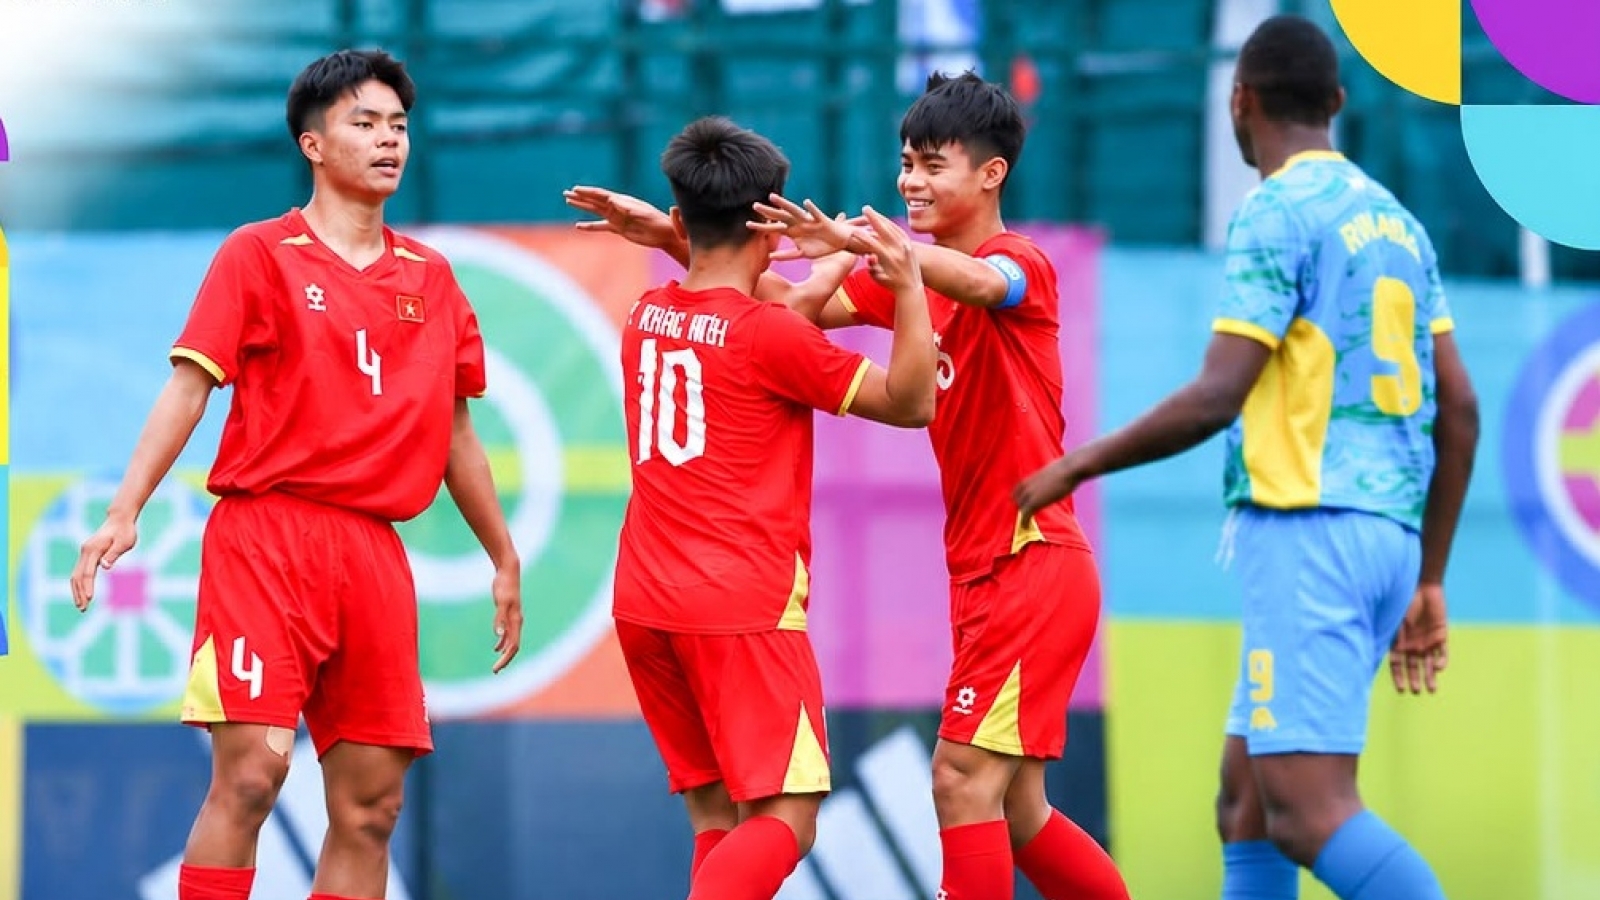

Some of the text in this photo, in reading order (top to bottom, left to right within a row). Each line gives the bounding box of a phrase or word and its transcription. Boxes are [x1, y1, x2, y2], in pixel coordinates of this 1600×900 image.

[356, 328, 382, 395] 4
[1371, 276, 1422, 416] 9
[637, 338, 706, 467] 10
[231, 635, 264, 701] 4
[1248, 649, 1274, 703] 9
